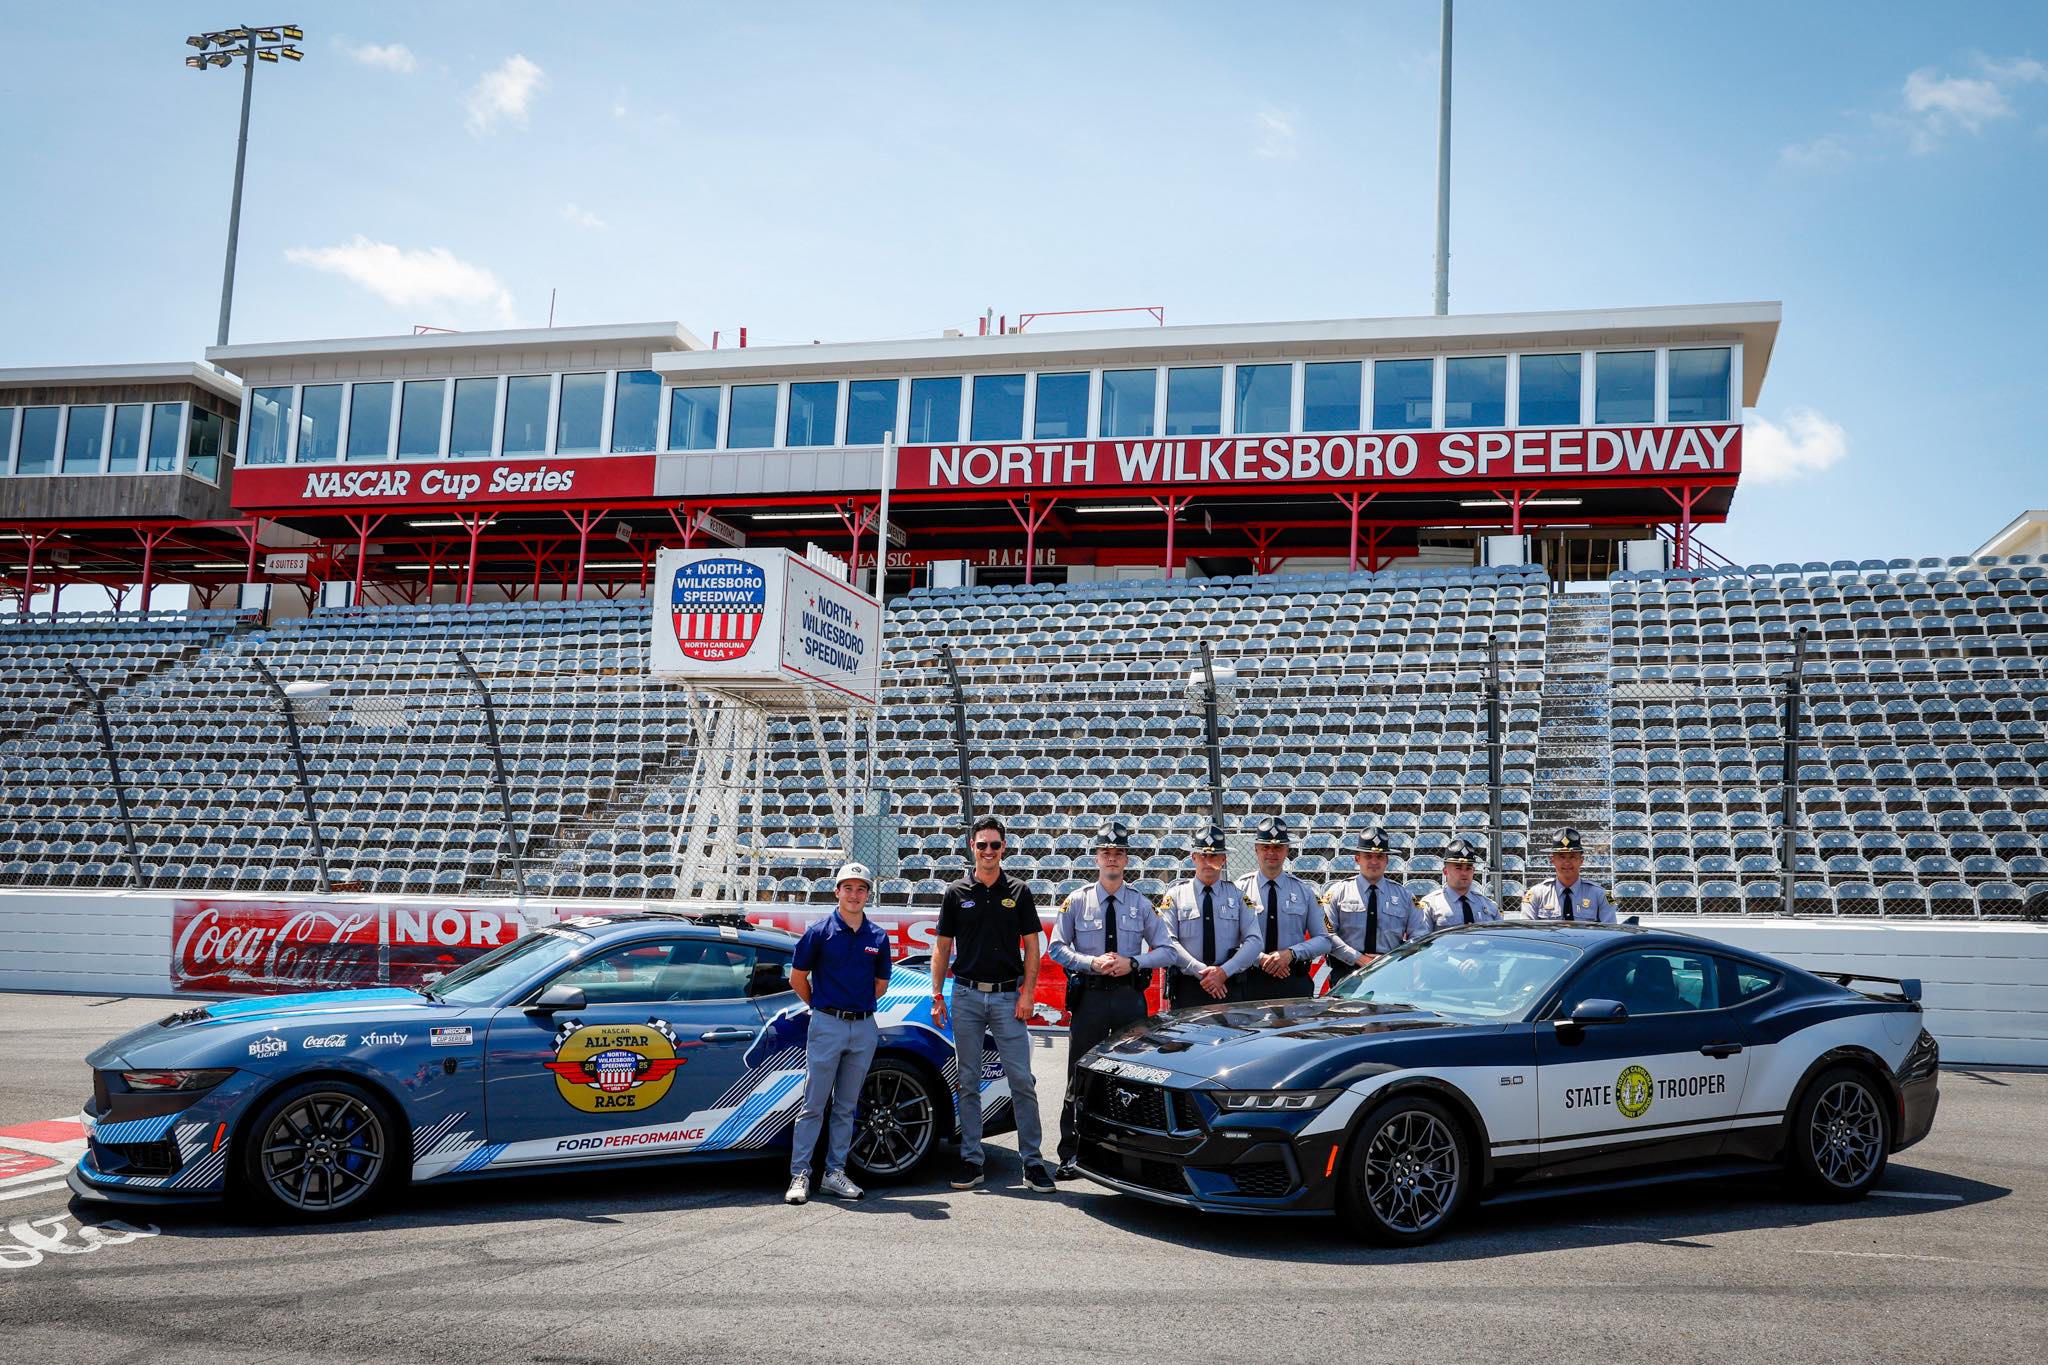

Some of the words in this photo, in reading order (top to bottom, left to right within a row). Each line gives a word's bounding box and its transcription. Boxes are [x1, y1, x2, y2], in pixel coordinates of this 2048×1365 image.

[928, 443, 1096, 486] NORTH
[1114, 434, 1418, 482] WILKESBORO
[1438, 428, 1740, 476] SPEEDWAY
[302, 470, 411, 498] NASCAR
[420, 469, 481, 500] Cup
[488, 466, 575, 493] Series
[275, 560, 298, 569] SUITES
[849, 552, 911, 567] LASIC
[988, 548, 1056, 567] RACNG
[697, 563, 743, 575] NORTH
[677, 577, 762, 589] WILKESBORO
[683, 590, 754, 602] SPEEDWAY
[818, 595, 852, 626] NORTH
[802, 610, 864, 656] WILKESBORO
[684, 641, 708, 649] NORTH
[709, 641, 745, 649] CAROLINA
[703, 649, 725, 658] USA
[805, 636, 859, 675] SPEEDWAY
[302, 1034, 348, 1049] Coca-Cola
[361, 1032, 408, 1047] xfinity
[248, 1039, 288, 1056] BUSCH
[257, 1050, 280, 1059] LIGHT
[584, 1063, 594, 1071] 20
[638, 1061, 648, 1069] 25
[980, 1063, 1004, 1079] Ford
[1565, 1086, 1611, 1108] STATE
[1658, 1075, 1725, 1099] TROOPER
[595, 1095, 636, 1108] RACE
[556, 1137, 603, 1151] FORD
[604, 1128, 705, 1148] PERFORMANCE
